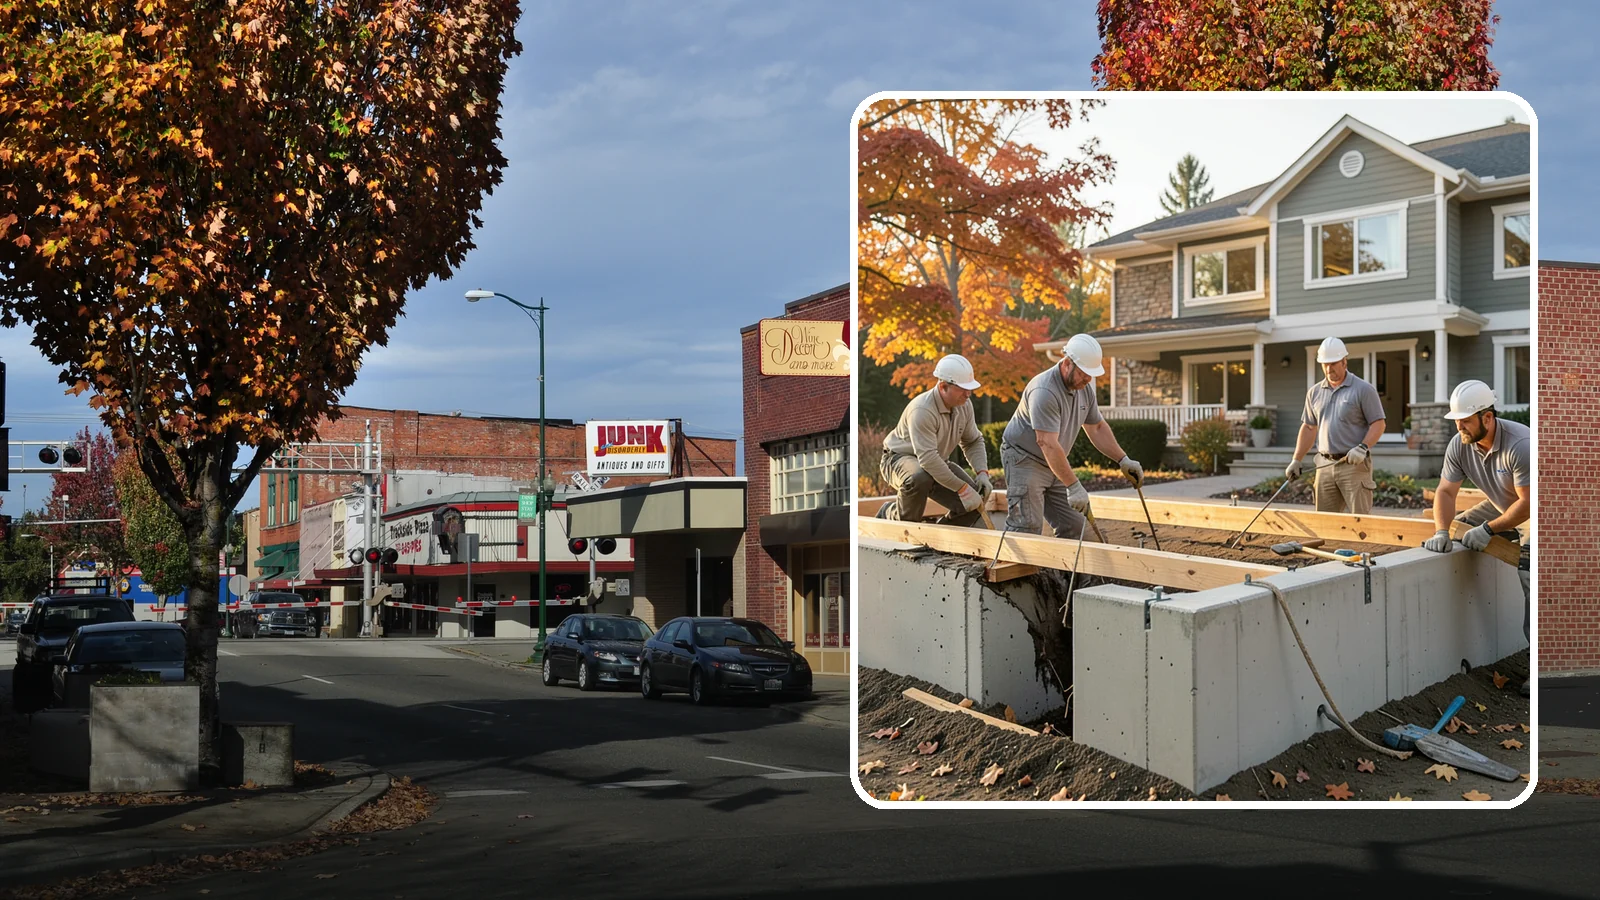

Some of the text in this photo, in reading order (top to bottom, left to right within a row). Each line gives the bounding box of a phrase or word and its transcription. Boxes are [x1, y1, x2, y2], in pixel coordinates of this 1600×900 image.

[595, 425, 666, 457] JUNK
[607, 446, 646, 454] DISORDERLY
[597, 460, 665, 470] ANTIQUES AND GIFTS
[414, 519, 429, 535] Pizza
